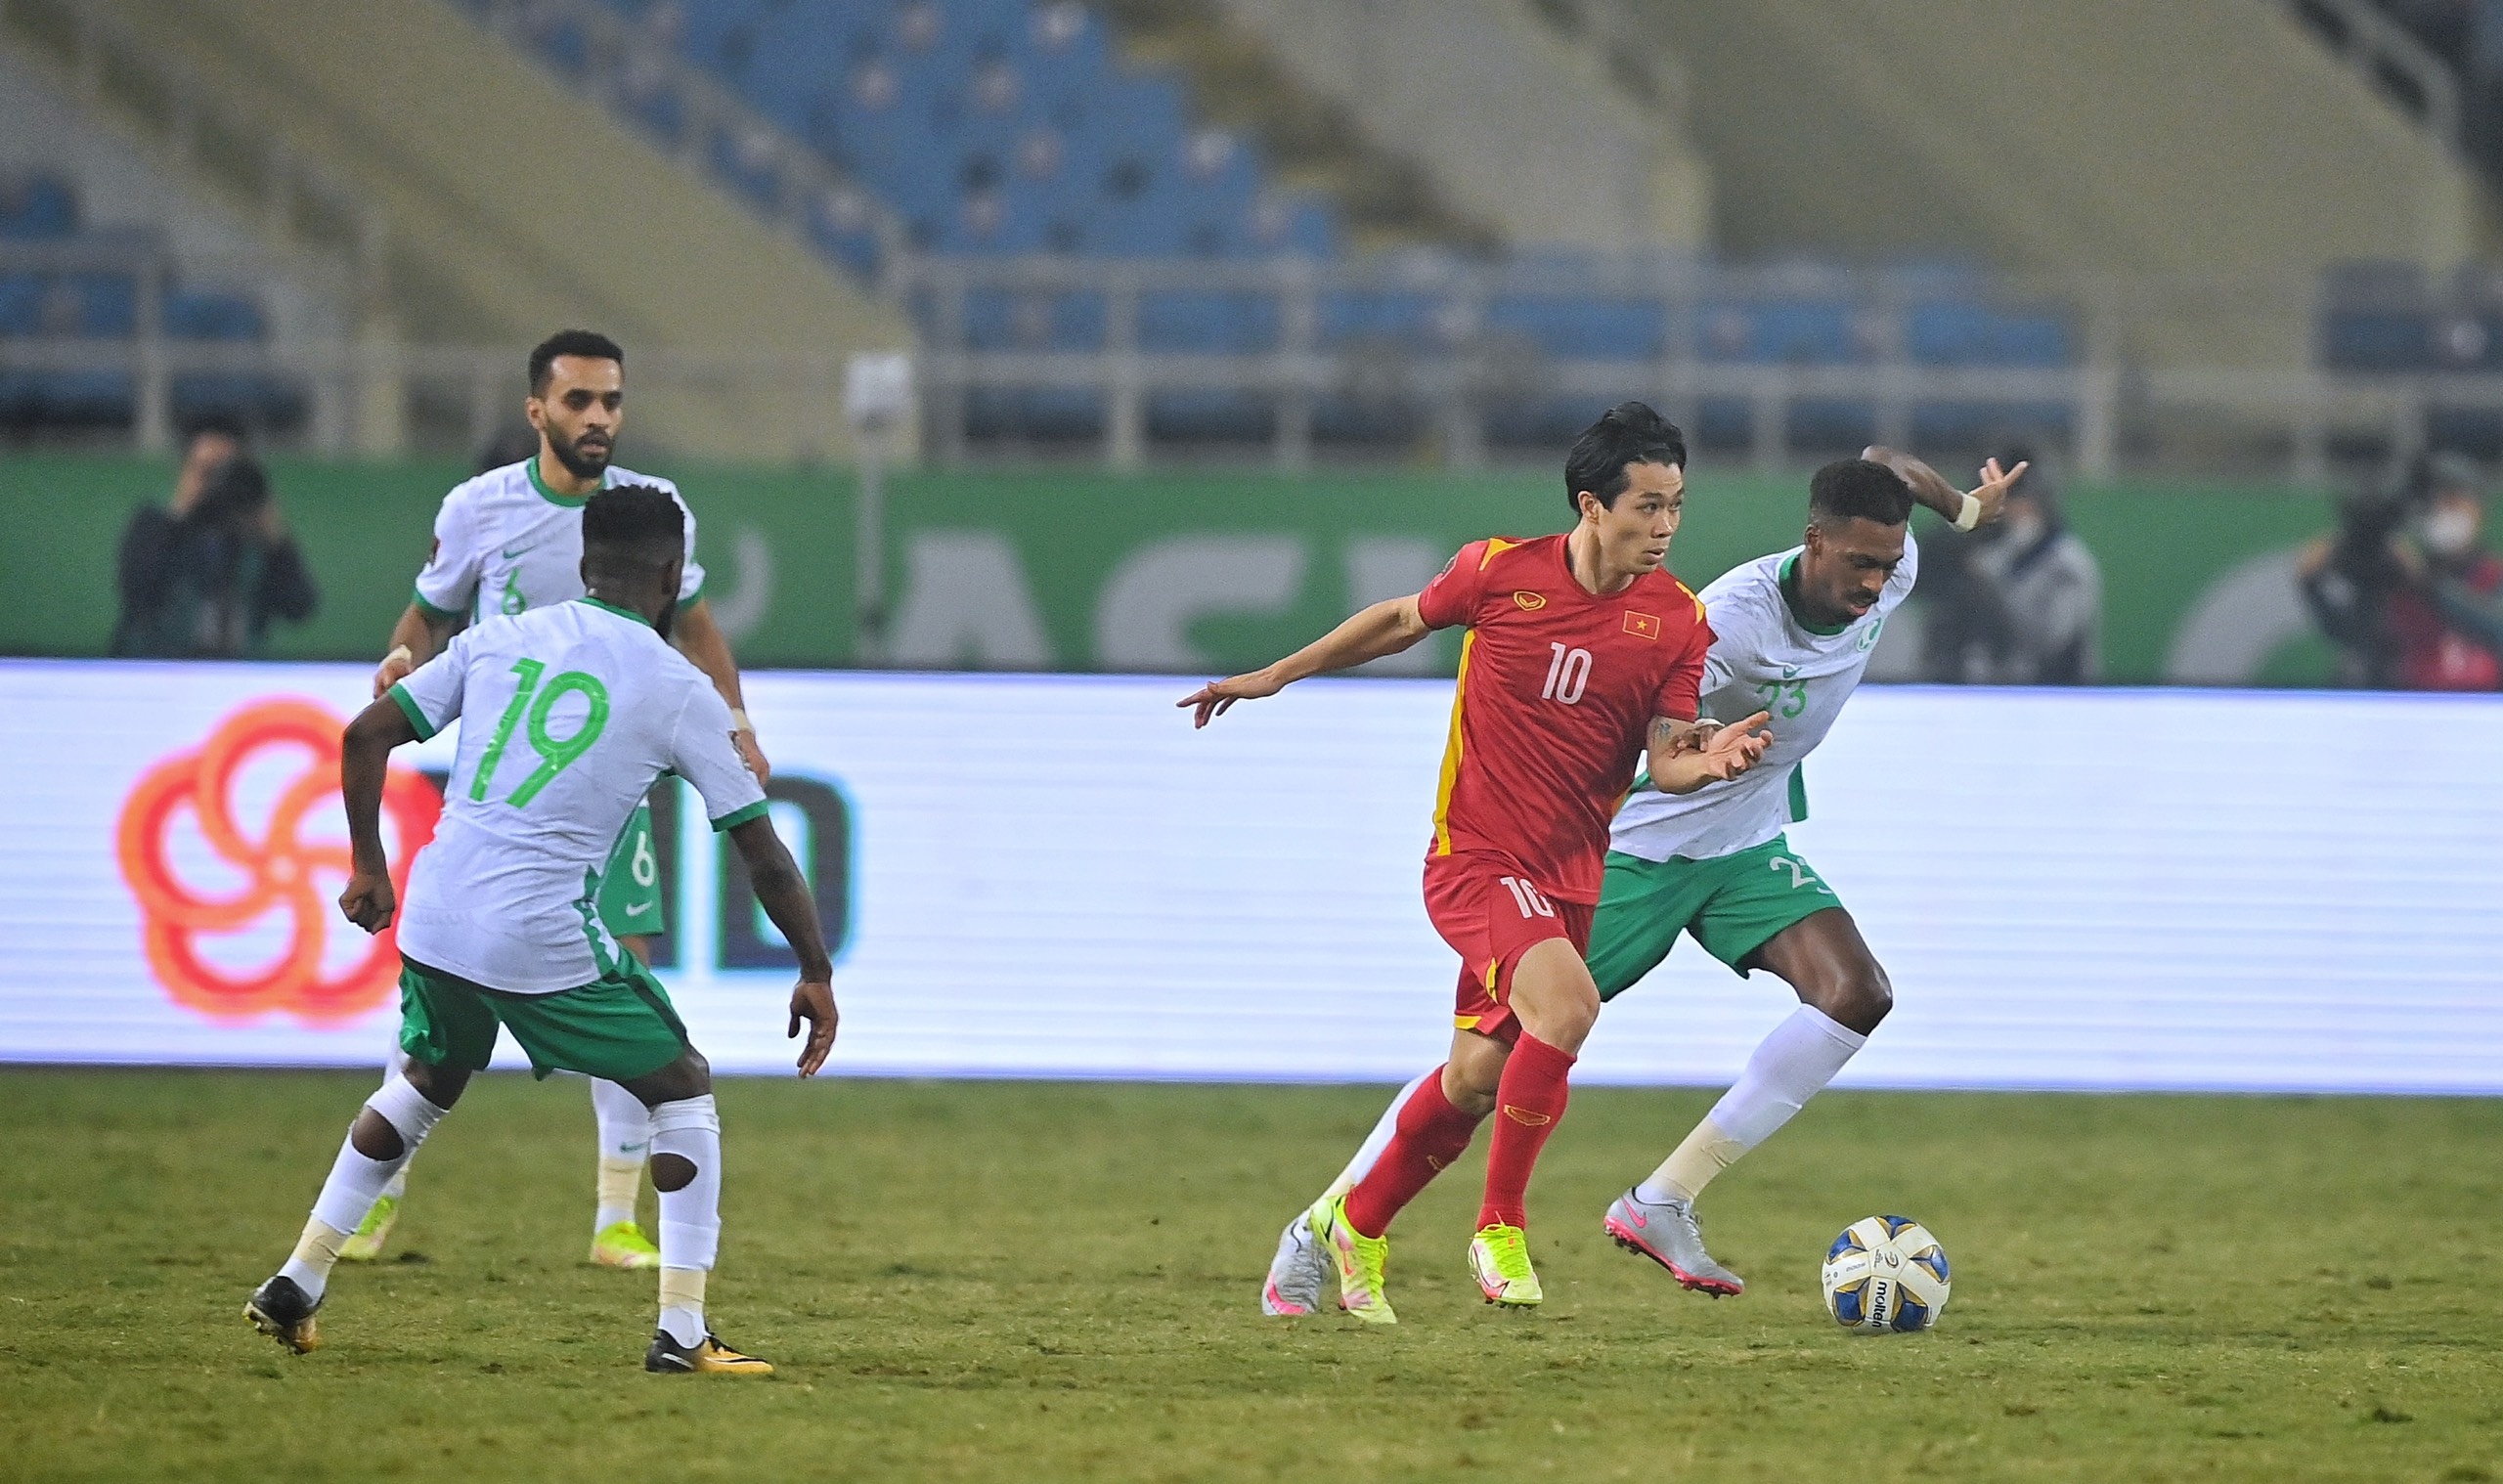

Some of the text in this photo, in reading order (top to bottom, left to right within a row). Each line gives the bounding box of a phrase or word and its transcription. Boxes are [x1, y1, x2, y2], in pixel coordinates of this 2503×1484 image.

[502, 567, 528, 615] 6
[1542, 641, 1593, 705] 10
[469, 657, 611, 809] 19
[632, 830, 655, 888] 6
[1769, 855, 1817, 890] 2
[1871, 1281, 1888, 1329] molten
